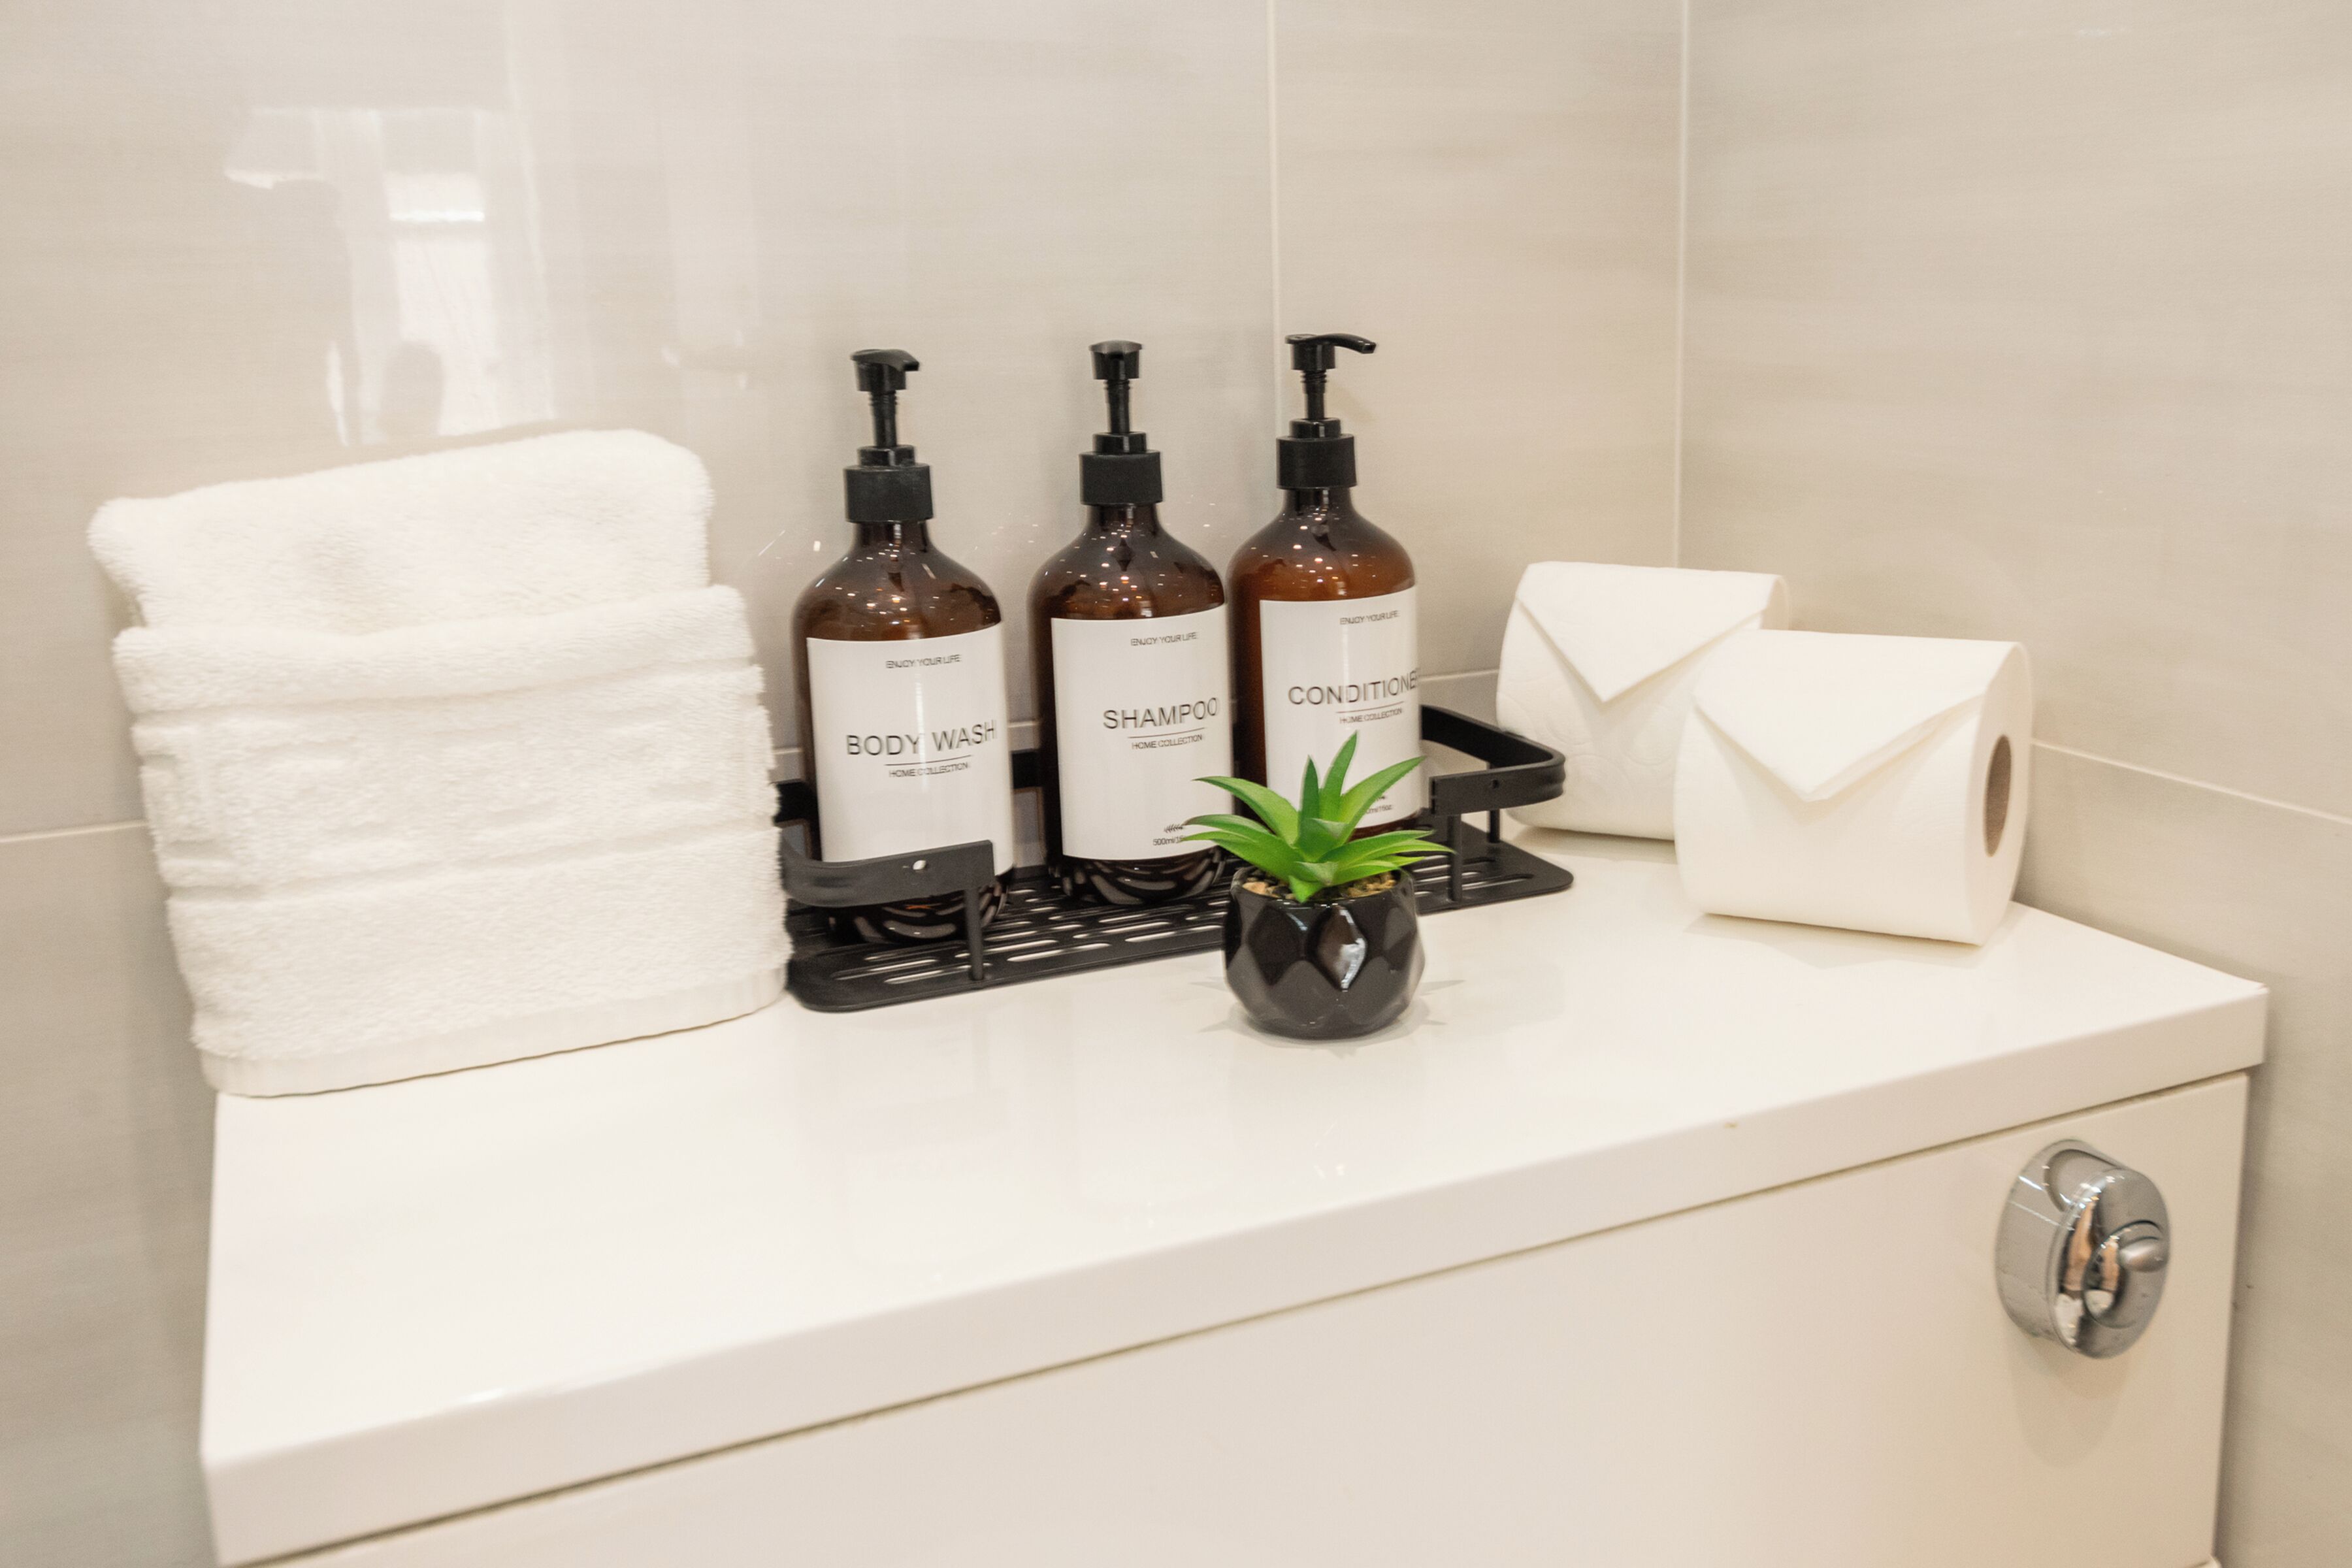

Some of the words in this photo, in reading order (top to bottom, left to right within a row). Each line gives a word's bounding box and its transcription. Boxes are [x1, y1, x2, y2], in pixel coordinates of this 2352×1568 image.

[1339, 615, 1365, 625] ENJOY
[1365, 612, 1386, 622] YOUR
[1386, 610, 1401, 619] LIFE
[1131, 636, 1158, 646] ENJOY
[1159, 634, 1181, 644] YOUR
[1182, 631, 1199, 641] LIFE
[886, 659, 915, 668] ENJOY
[917, 656, 941, 666] YOUR
[943, 653, 961, 664] LIFE
[1288, 669, 1419, 705] CONDITIONE
[1103, 696, 1218, 729] SHAMPOO
[1339, 715, 1364, 724] HOME
[1364, 706, 1403, 722] COLLECTION
[846, 734, 922, 755] BODY
[931, 719, 997, 751] WASH
[1132, 740, 1157, 750] HOME
[1158, 733, 1203, 747] COLLECTION
[889, 768, 917, 777] HOME
[917, 761, 970, 776] COLLECTION
